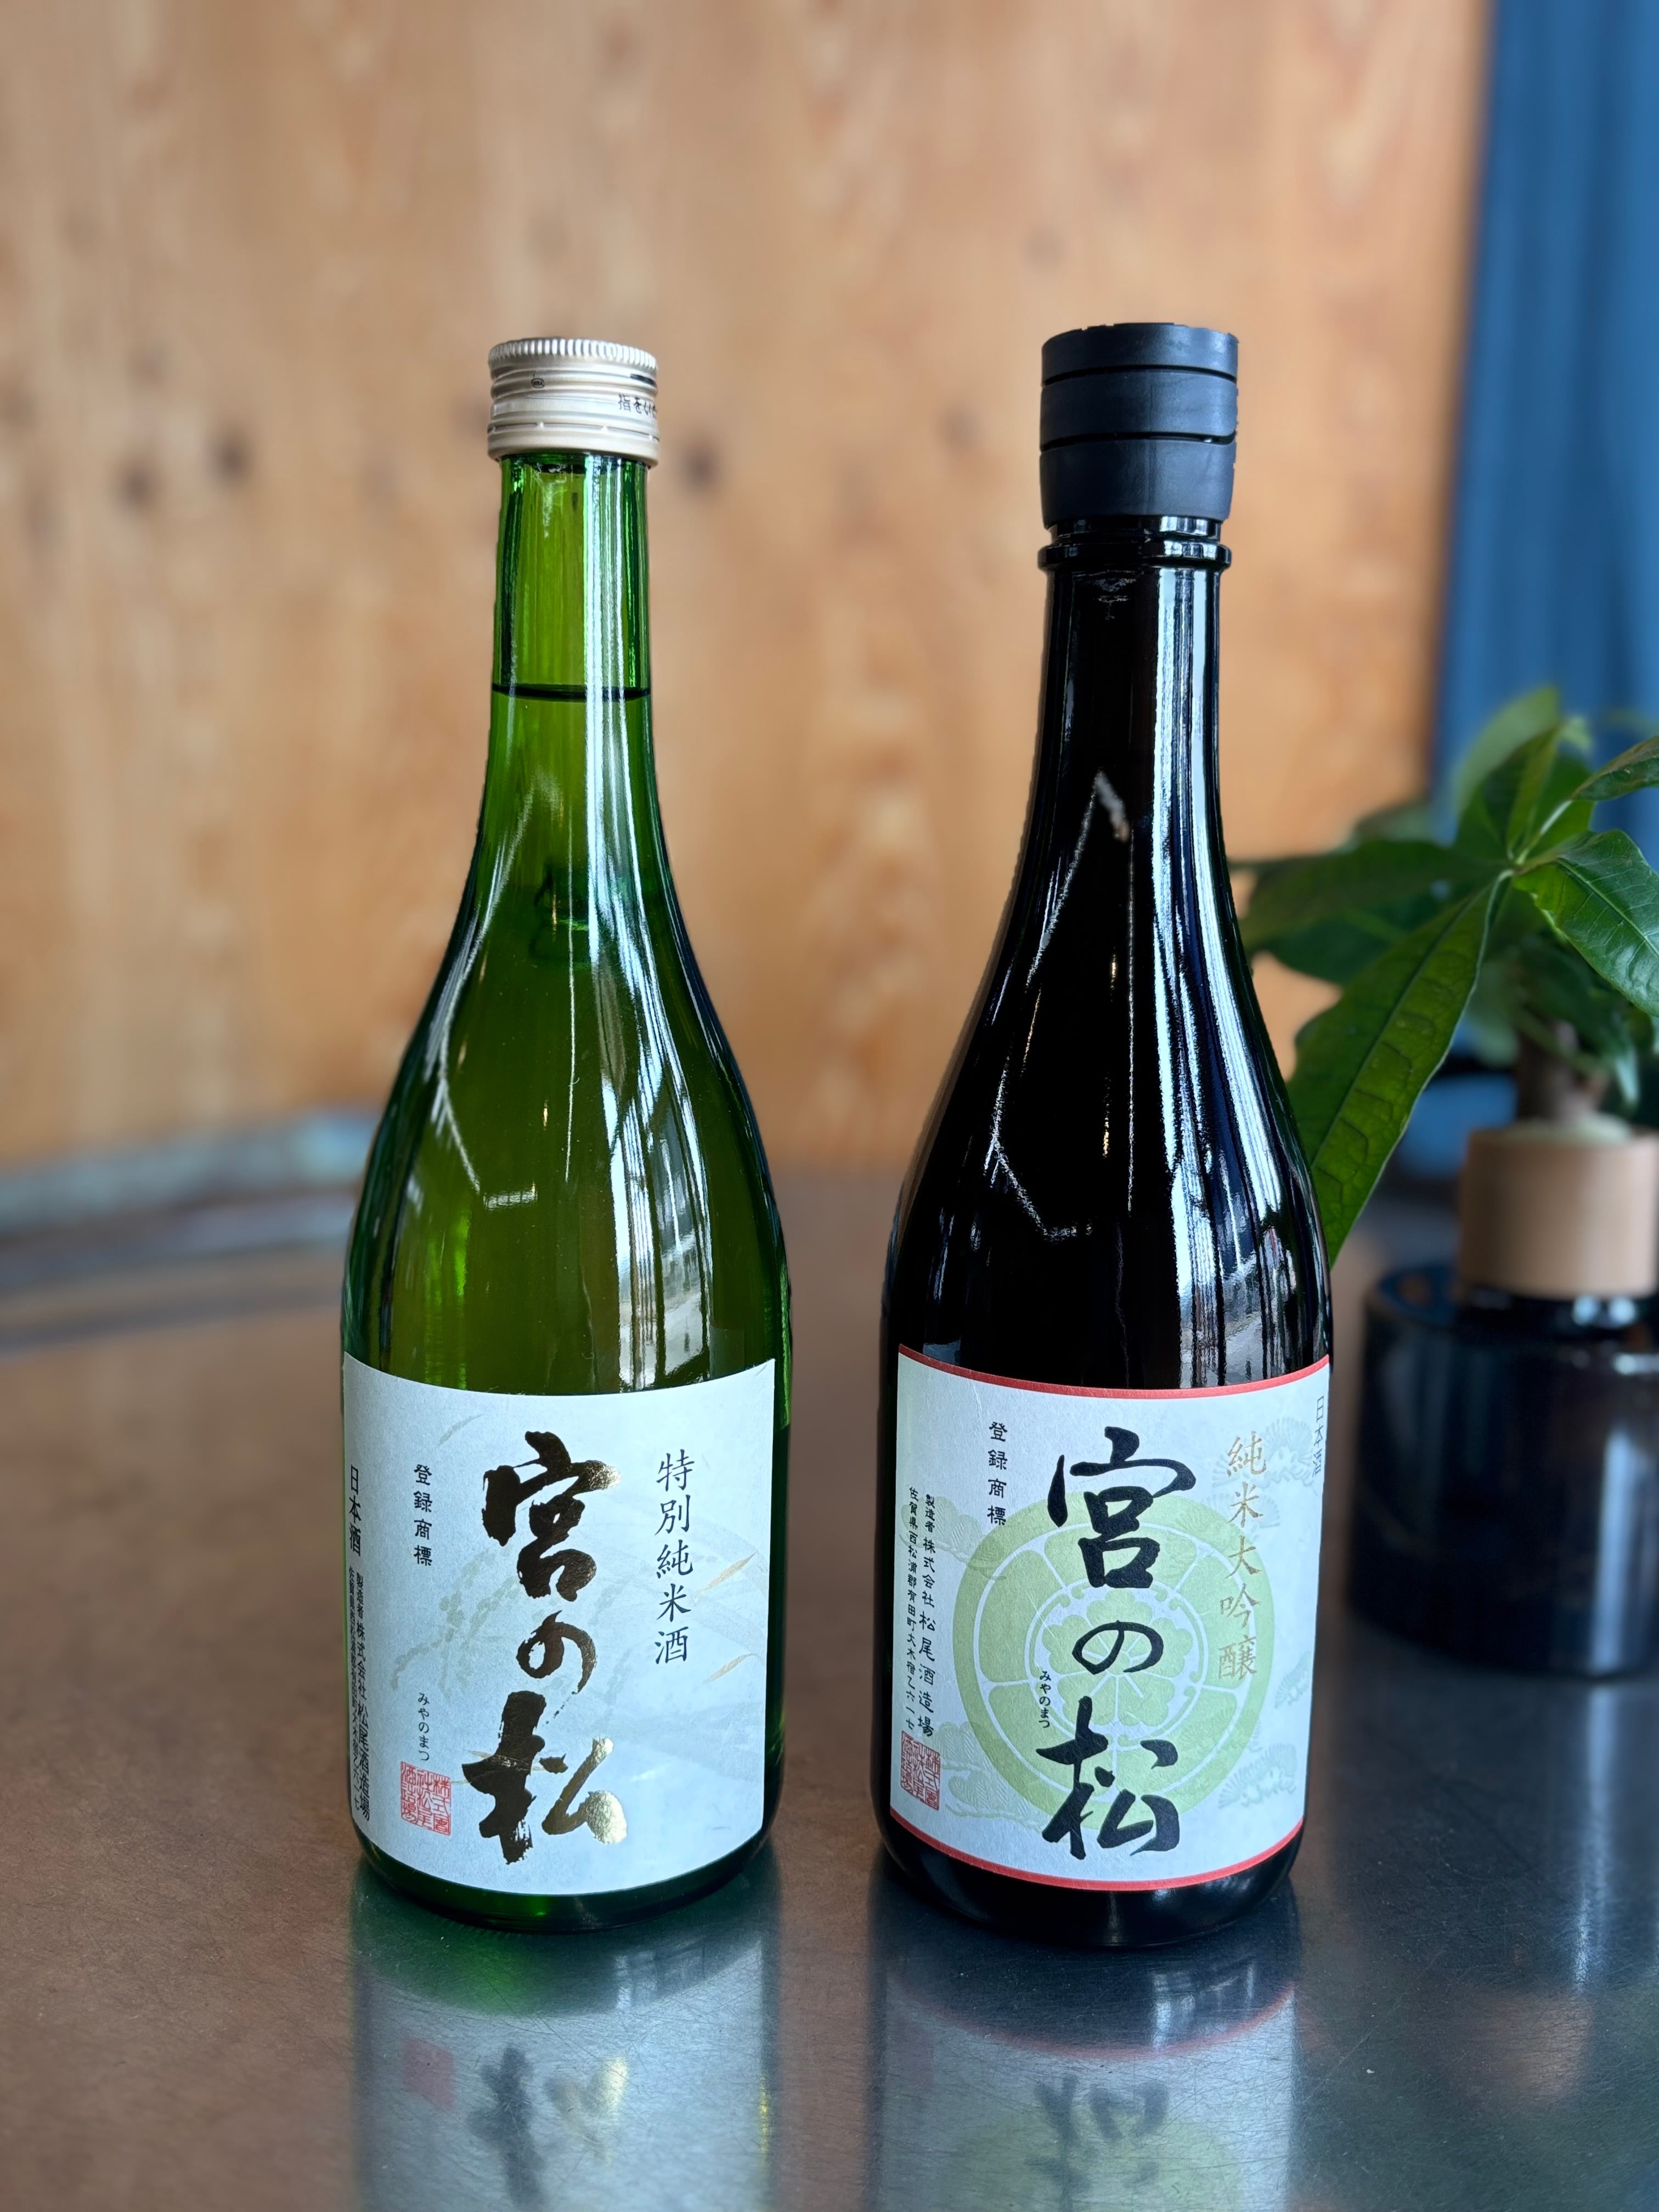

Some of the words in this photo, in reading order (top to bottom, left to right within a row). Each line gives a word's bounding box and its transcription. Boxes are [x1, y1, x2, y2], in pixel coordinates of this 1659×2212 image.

[349, 1464, 361, 1556] 日本酒
[414, 1464, 432, 1566] 登録商標
[987, 1421, 1008, 1526] 登録商標
[654, 1449, 695, 1664] 特別純米酒
[1218, 1430, 1267, 1681] 純米大吟醸
[461, 1431, 628, 1865] 宮の松
[1036, 1426, 1196, 1859] 宮の松
[417, 1692, 430, 1761] みやのまつ
[1039, 1671, 1052, 1728] みやのまつ
